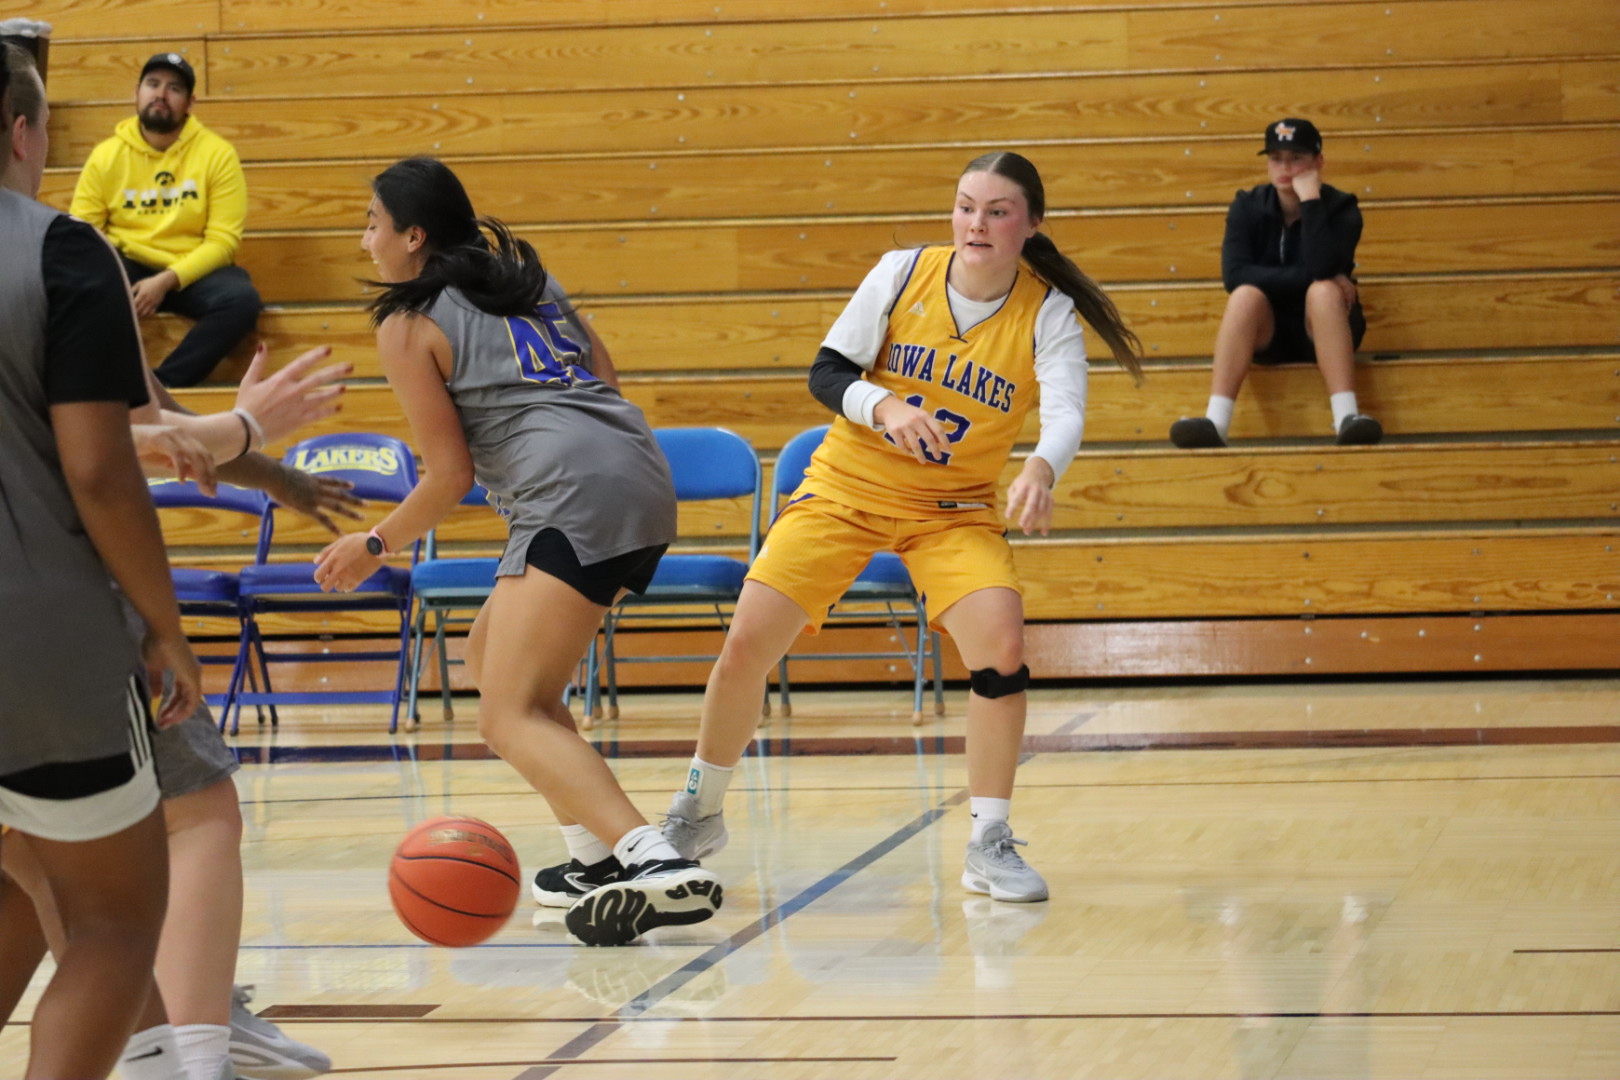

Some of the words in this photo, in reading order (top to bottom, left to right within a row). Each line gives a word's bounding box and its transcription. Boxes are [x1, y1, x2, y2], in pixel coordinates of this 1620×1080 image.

[887, 343, 937, 382] IOWA
[942, 354, 1015, 413] LAKES
[294, 447, 399, 474] LAKERS
